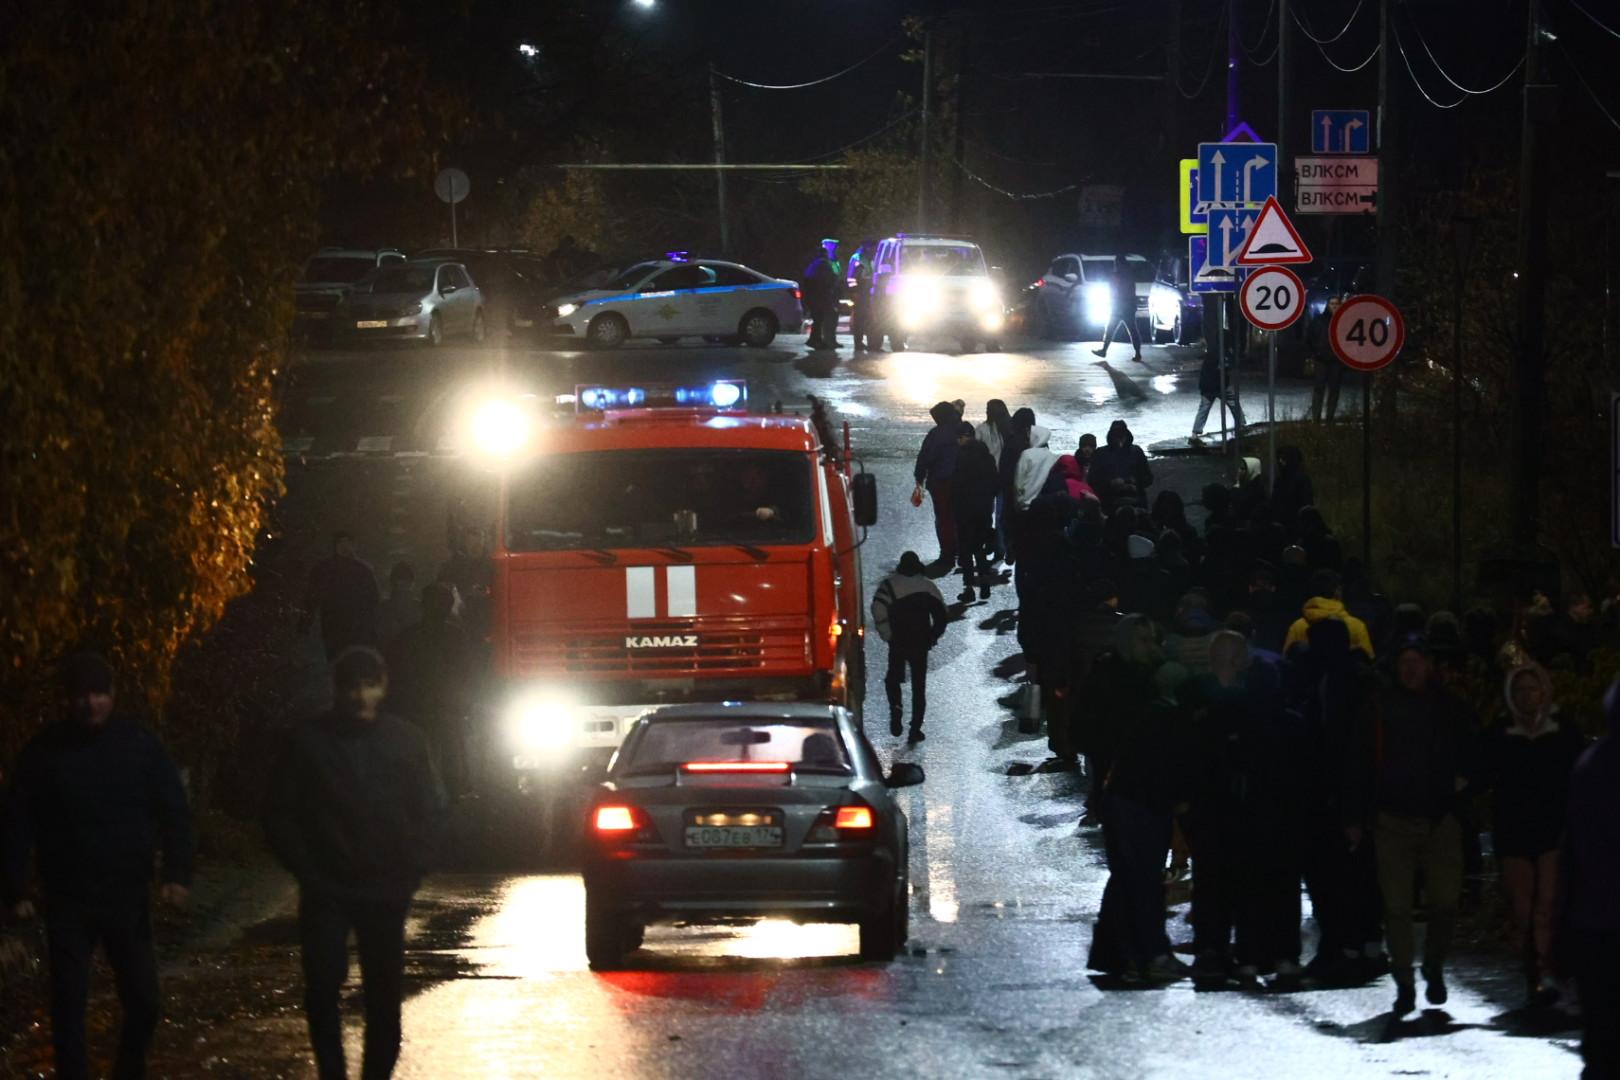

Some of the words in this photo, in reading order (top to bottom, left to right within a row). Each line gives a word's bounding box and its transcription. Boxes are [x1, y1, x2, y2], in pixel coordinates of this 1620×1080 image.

[1301, 164, 1359, 178] ВЛКСМ
[1301, 191, 1359, 206] ВЛКСМ
[1255, 285, 1291, 310] 20
[1345, 318, 1388, 347] 40
[625, 635, 698, 648] KAMAZ
